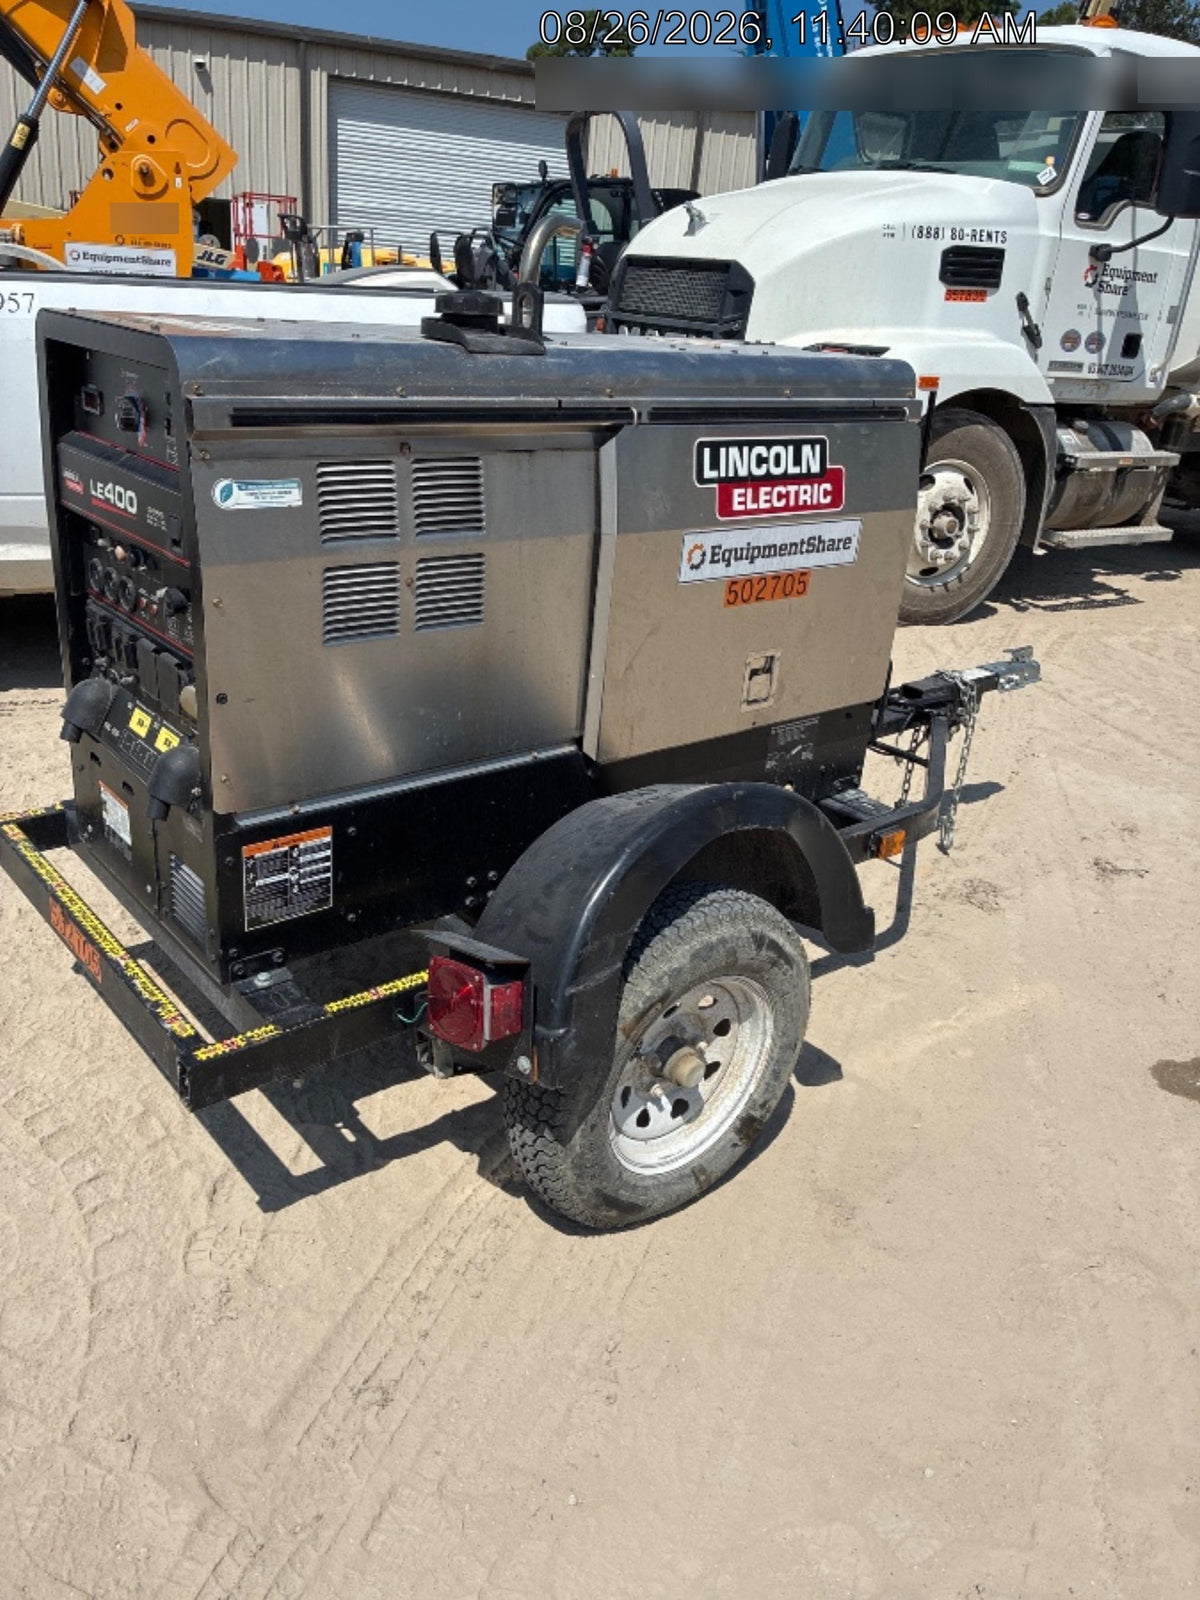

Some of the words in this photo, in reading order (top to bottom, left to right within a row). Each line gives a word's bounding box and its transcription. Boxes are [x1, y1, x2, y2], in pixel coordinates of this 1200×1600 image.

[911, 225, 945, 241] (888)
[950, 227, 1008, 245] 80-RENTS
[82, 251, 172, 267] EquipmentShare
[197, 250, 228, 265] JLG
[1101, 263, 1158, 284] Equipment
[1097, 280, 1129, 296] Share
[703, 444, 820, 479] LINCOLN
[89, 478, 138, 515] LE400
[732, 483, 832, 511] ELECTRIC
[709, 534, 852, 568] EquipmentShare
[726, 571, 810, 606] 502705
